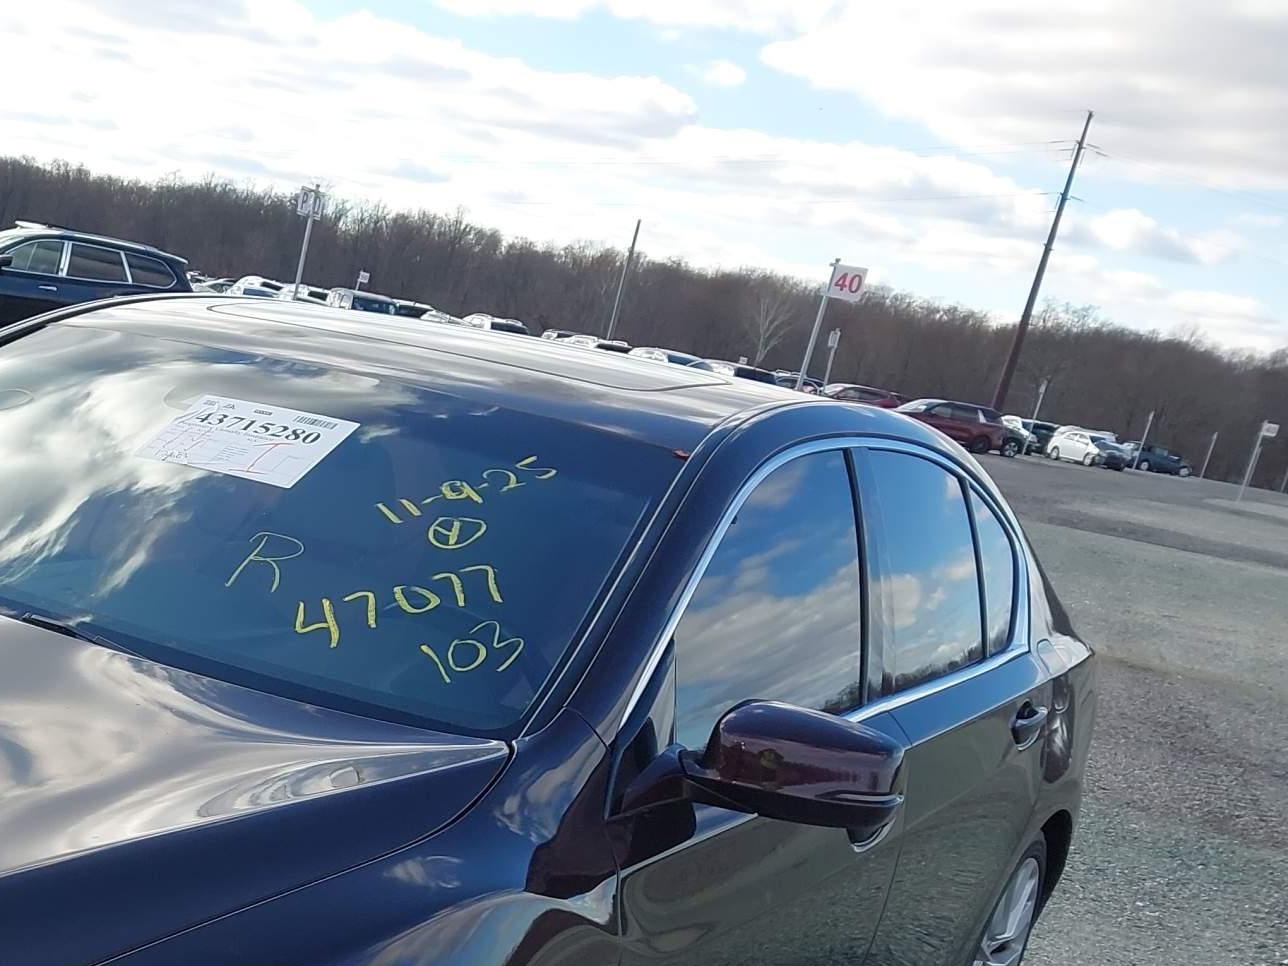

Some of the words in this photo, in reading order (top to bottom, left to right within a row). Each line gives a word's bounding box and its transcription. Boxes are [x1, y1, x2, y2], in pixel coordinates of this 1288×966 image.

[835, 272, 862, 293] 40
[196, 412, 321, 444] 43715280
[376, 455, 558, 524] 11-9-25
[225, 531, 304, 593] R
[295, 565, 503, 648] 47077
[420, 620, 524, 683] 103
